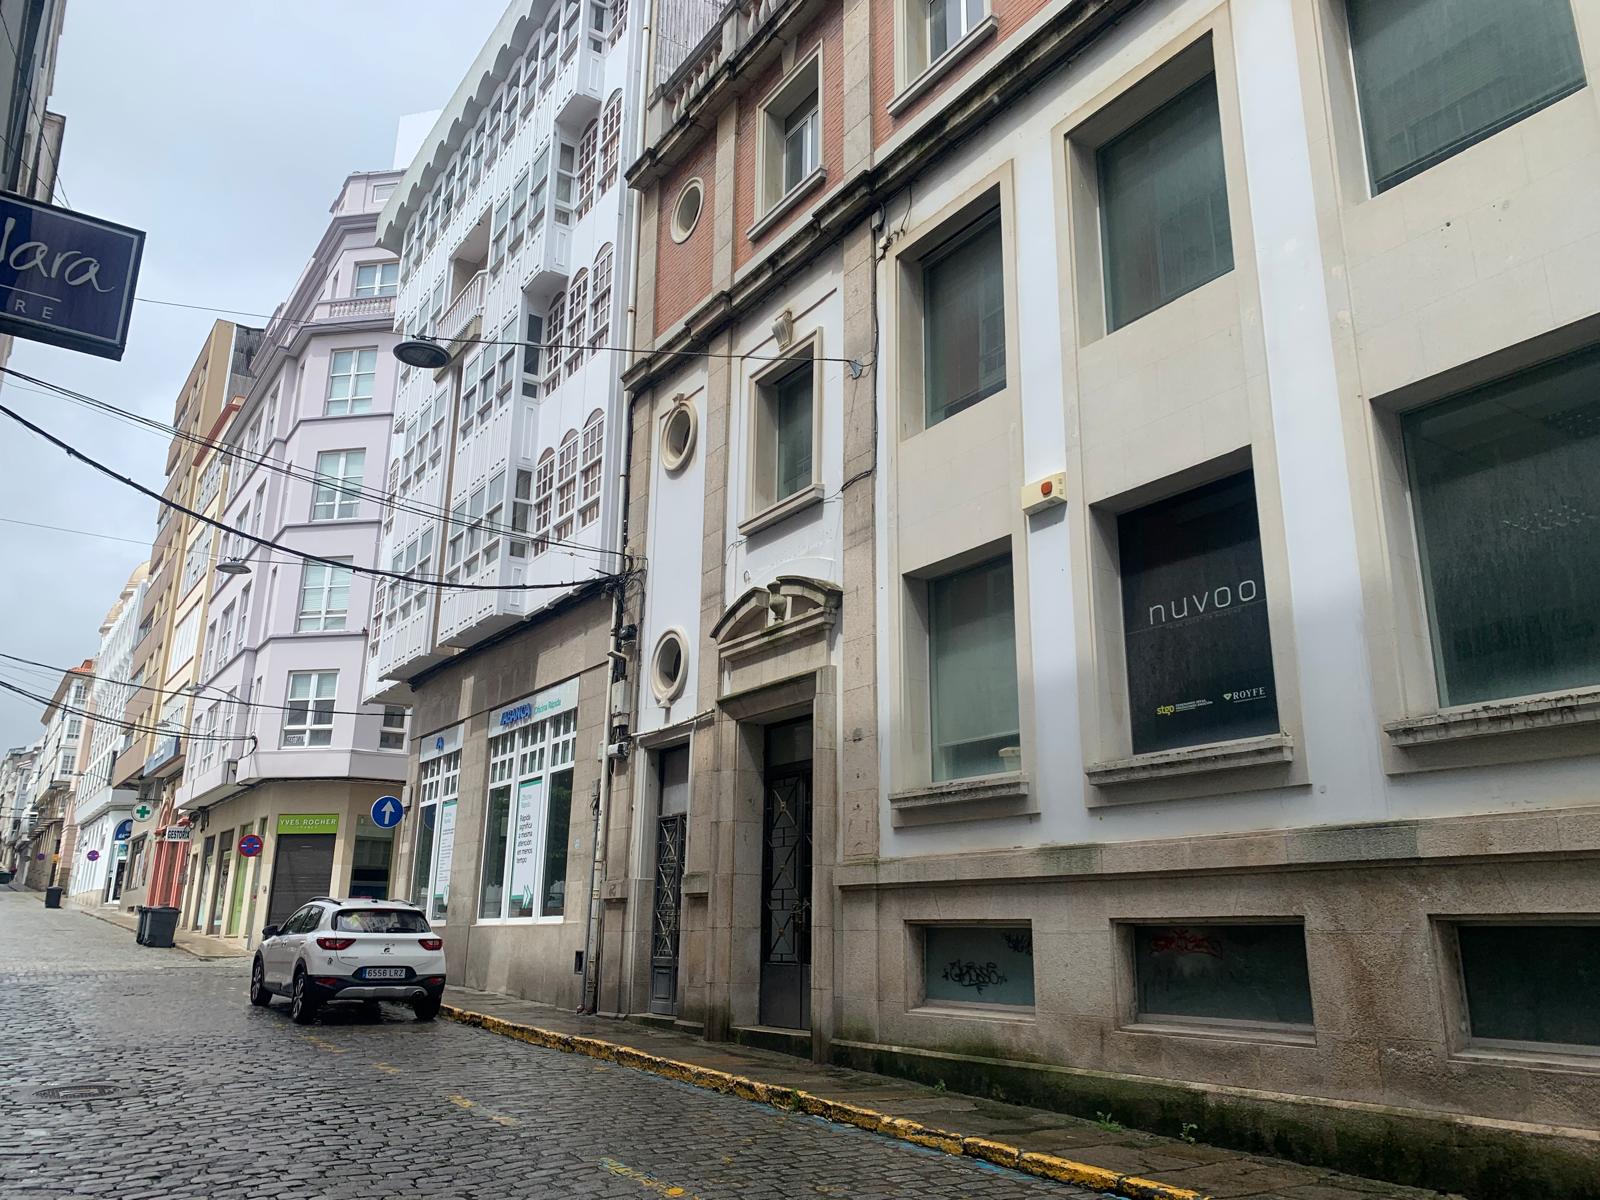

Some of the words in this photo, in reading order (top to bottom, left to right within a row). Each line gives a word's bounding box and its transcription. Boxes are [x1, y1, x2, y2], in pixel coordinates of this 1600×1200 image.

[1149, 579, 1256, 624] nuvoo
[1232, 686, 1266, 700] ROYFE
[501, 703, 532, 725] ABANCA
[303, 818, 337, 826] ROCHER
[389, 969, 404, 977] LRZ
